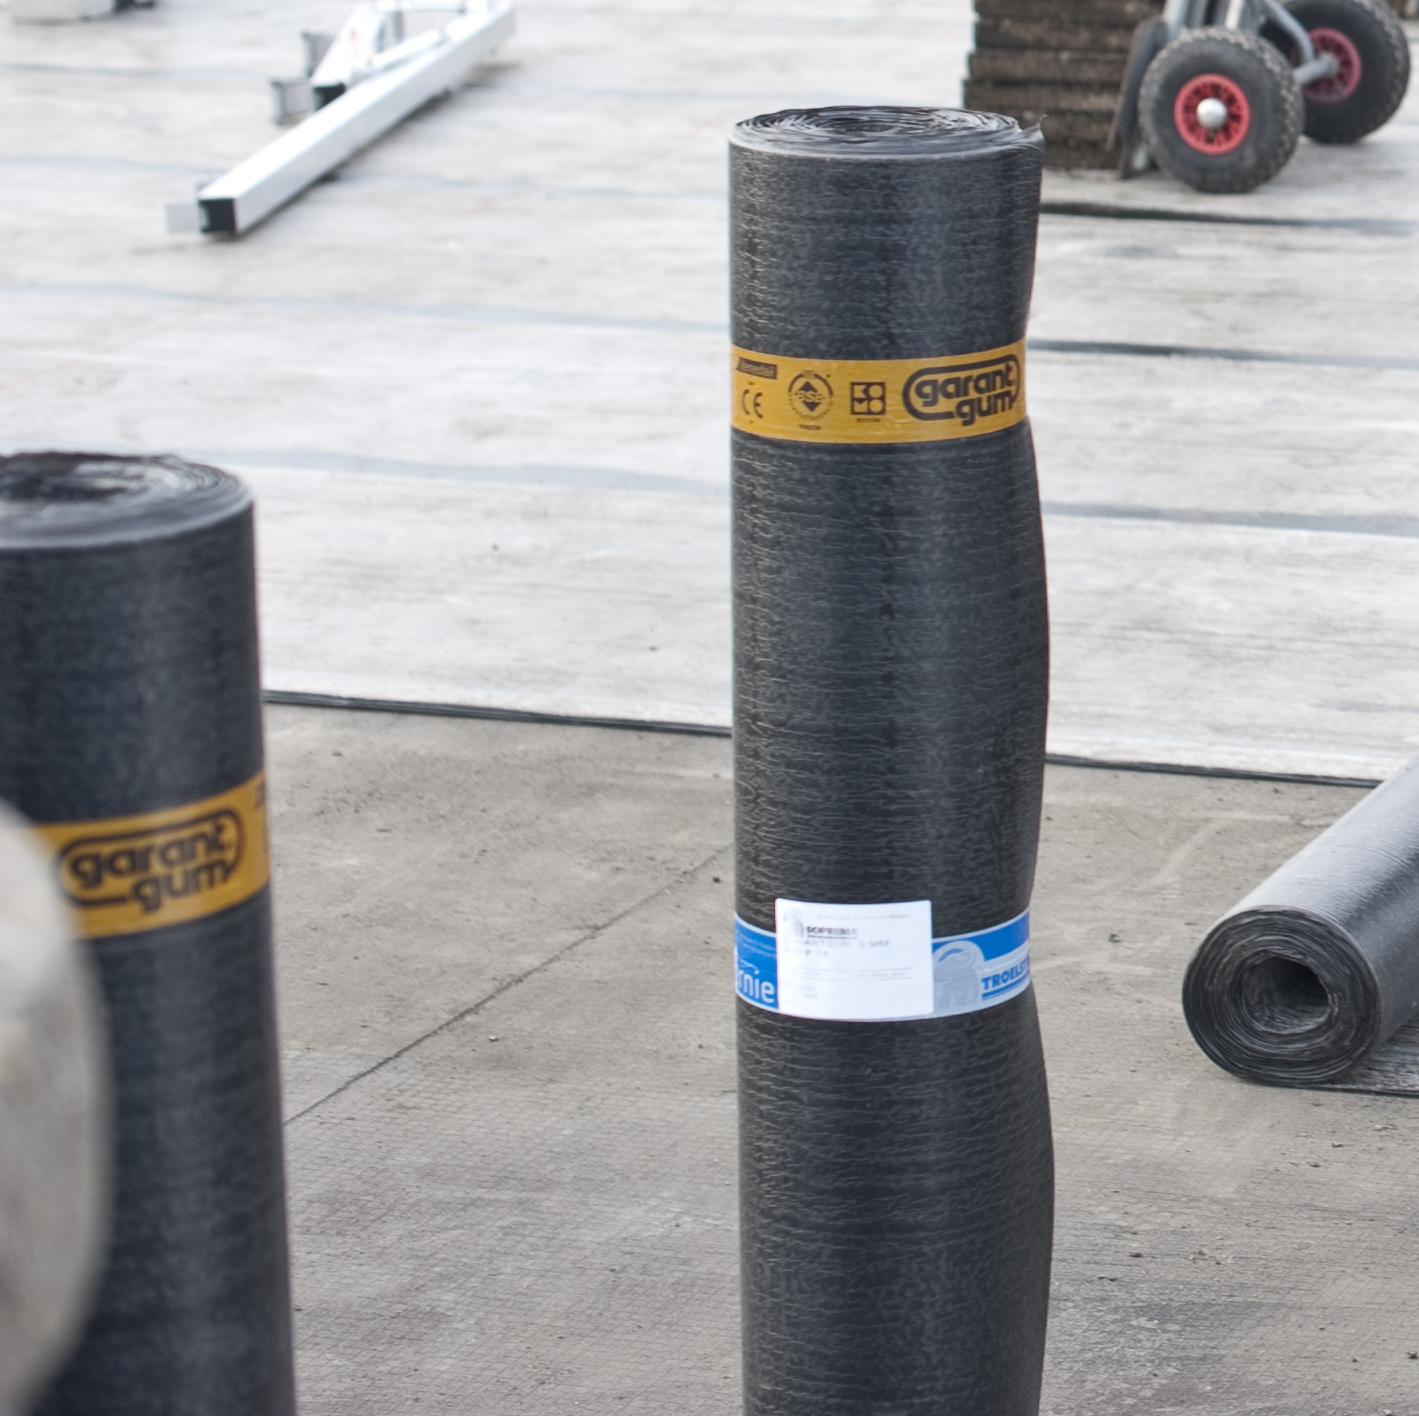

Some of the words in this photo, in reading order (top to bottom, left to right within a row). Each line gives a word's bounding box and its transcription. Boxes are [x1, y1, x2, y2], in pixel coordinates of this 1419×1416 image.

[914, 363, 1013, 407] garant
[955, 389, 1013, 427] gum
[72, 822, 224, 888] garant
[133, 860, 229, 915] gum
